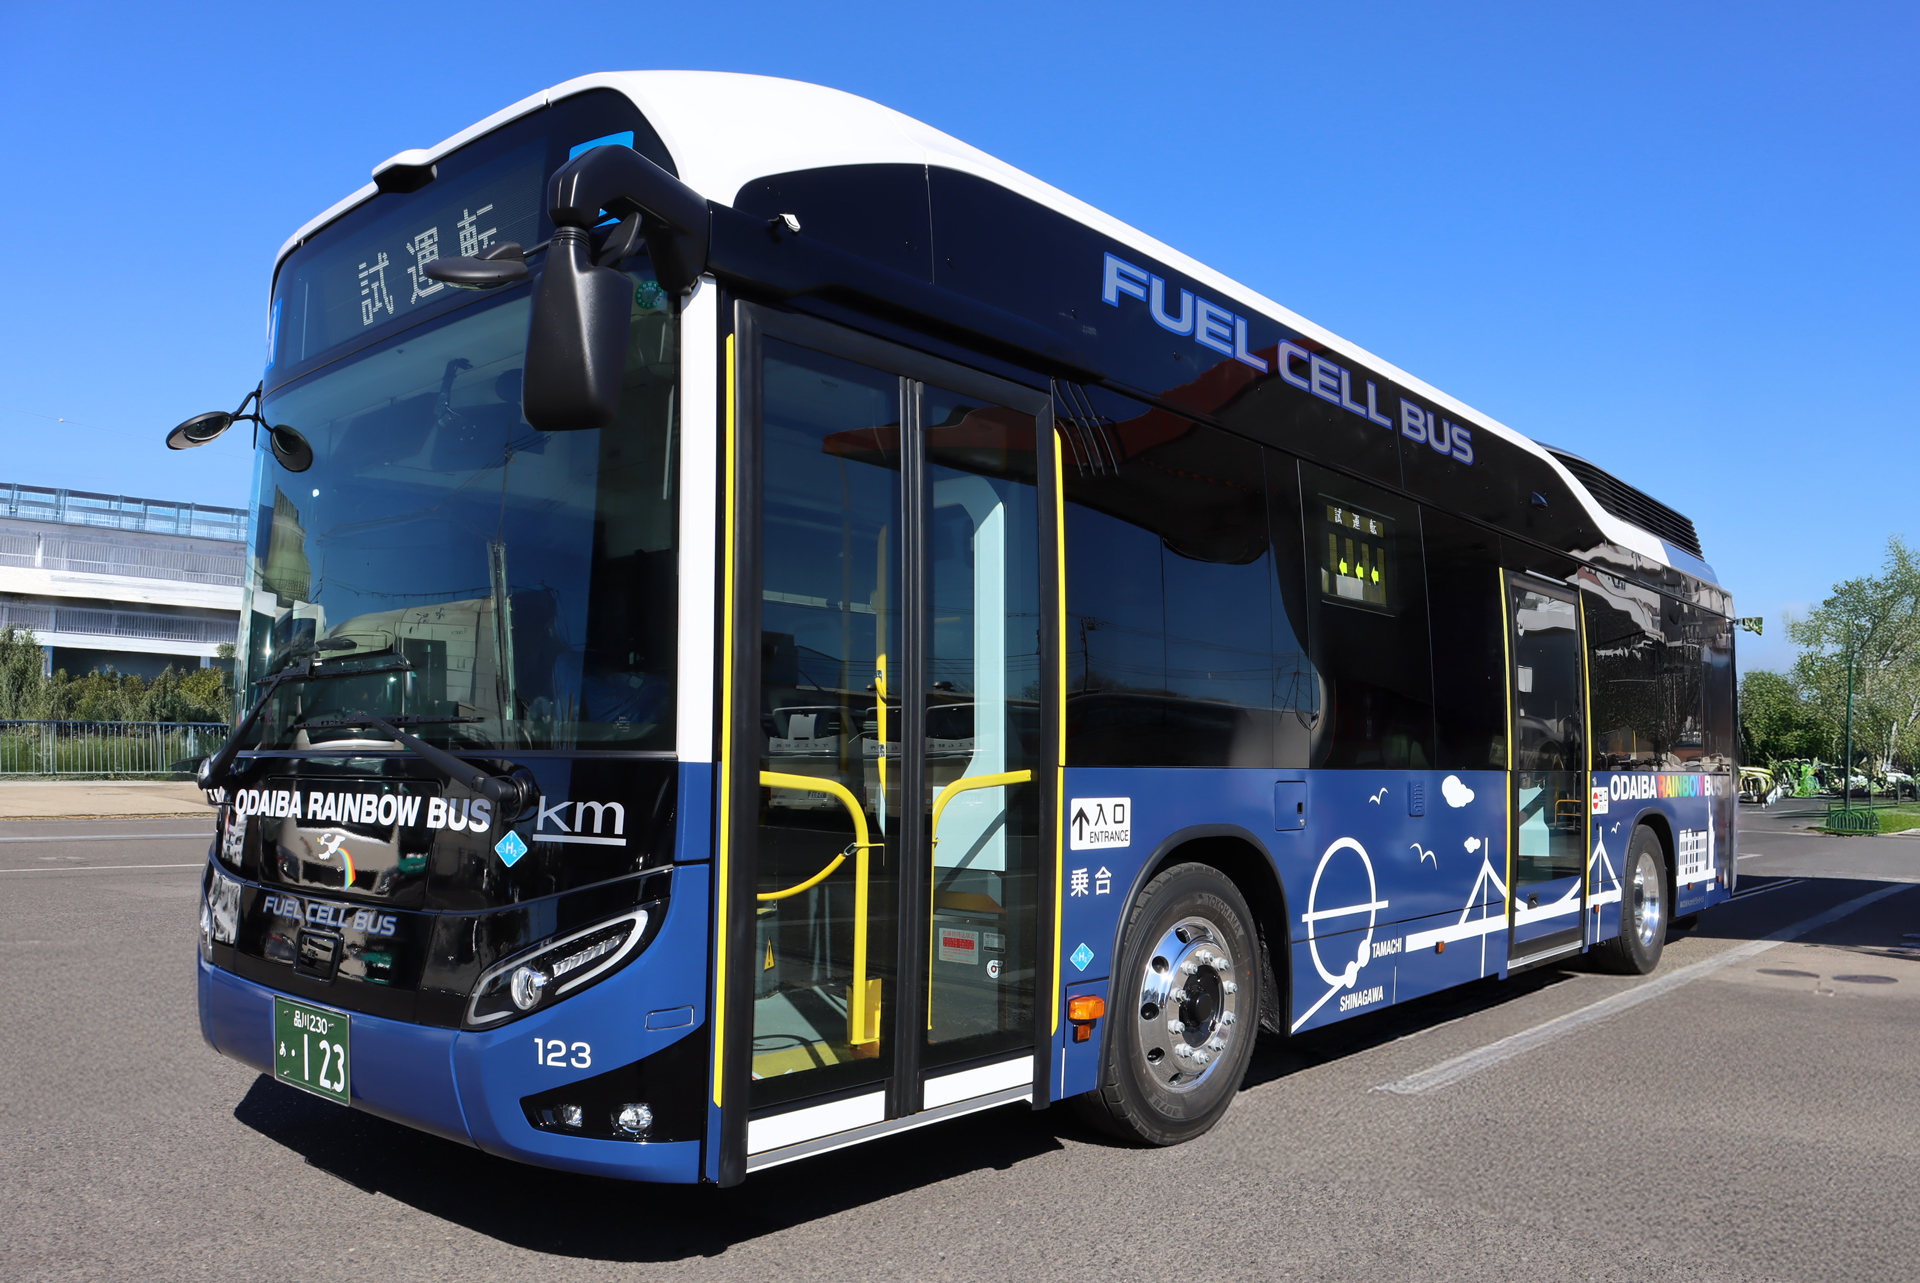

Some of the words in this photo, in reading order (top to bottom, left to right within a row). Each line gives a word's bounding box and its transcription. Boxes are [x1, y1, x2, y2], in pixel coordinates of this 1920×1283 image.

[1102, 251, 1268, 373] FUEL
[1277, 338, 1392, 430] CELL
[1400, 397, 1474, 466] BUS
[1610, 774, 1658, 802] ODAIBA
[1657, 774, 1705, 799] RAINBOW
[1704, 775, 1723, 797] BUS
[235, 789, 302, 820] ODAIBA
[307, 791, 422, 827] RAINBOW
[426, 795, 492, 833] BUS
[536, 795, 627, 836] km
[1094, 803, 1125, 827] 入口
[1089, 829, 1129, 844] ENTRANCE
[1070, 866, 1112, 898] 乗合
[262, 896, 302, 920] FUEL
[306, 904, 351, 930] CELL
[353, 912, 397, 938] BUS
[1206, 894, 1242, 935] YOKOHAMA
[1372, 937, 1403, 959] TAMACHI
[1339, 985, 1384, 1013] SHINAGAWA
[293, 1010, 328, 1035] 品川230
[533, 1037, 592, 1069] 123
